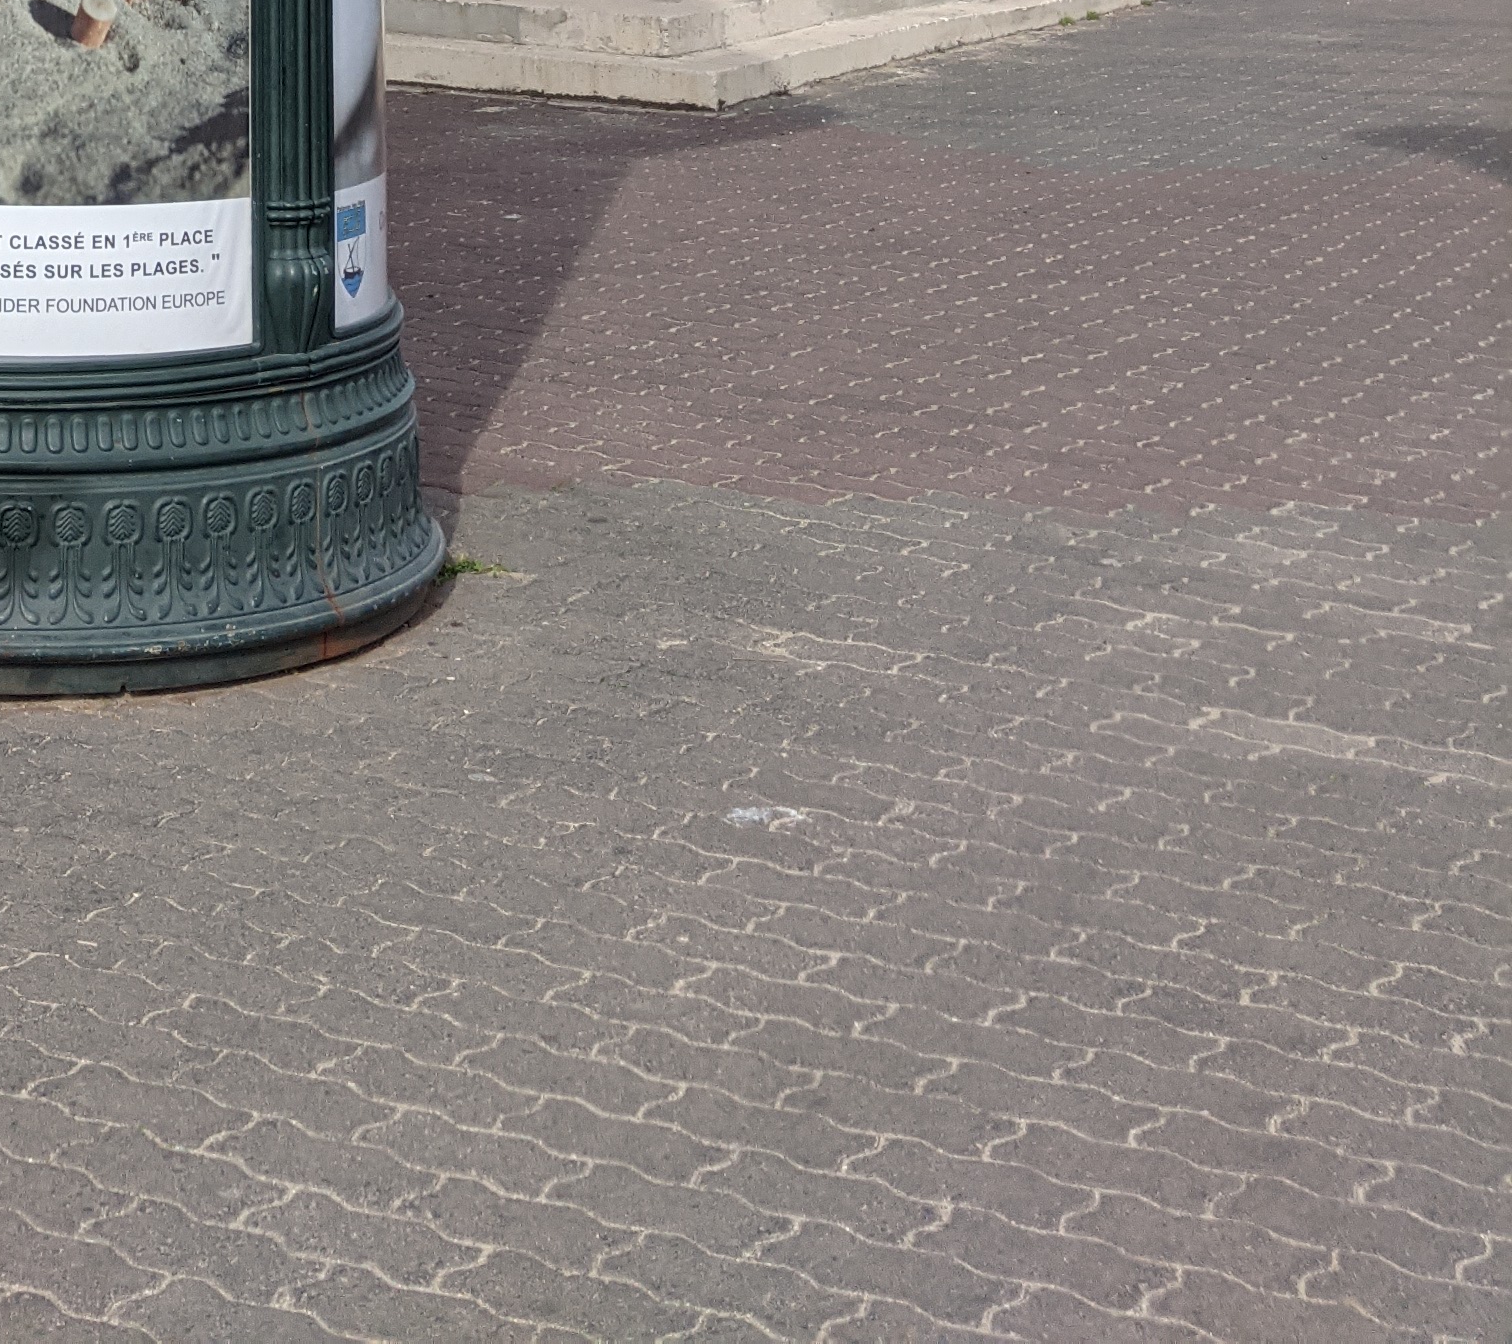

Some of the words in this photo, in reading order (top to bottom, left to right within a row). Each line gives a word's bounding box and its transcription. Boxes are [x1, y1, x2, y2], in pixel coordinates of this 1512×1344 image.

[9, 231, 85, 250] CLASSÉ
[91, 234, 116, 250] EN
[159, 229, 214, 247] PLACE
[43, 264, 83, 279] SUR
[89, 263, 124, 279] LES
[130, 258, 204, 278] PLAGES.
[45, 295, 157, 313] FOUNDATION
[161, 290, 226, 310] EUROPE
